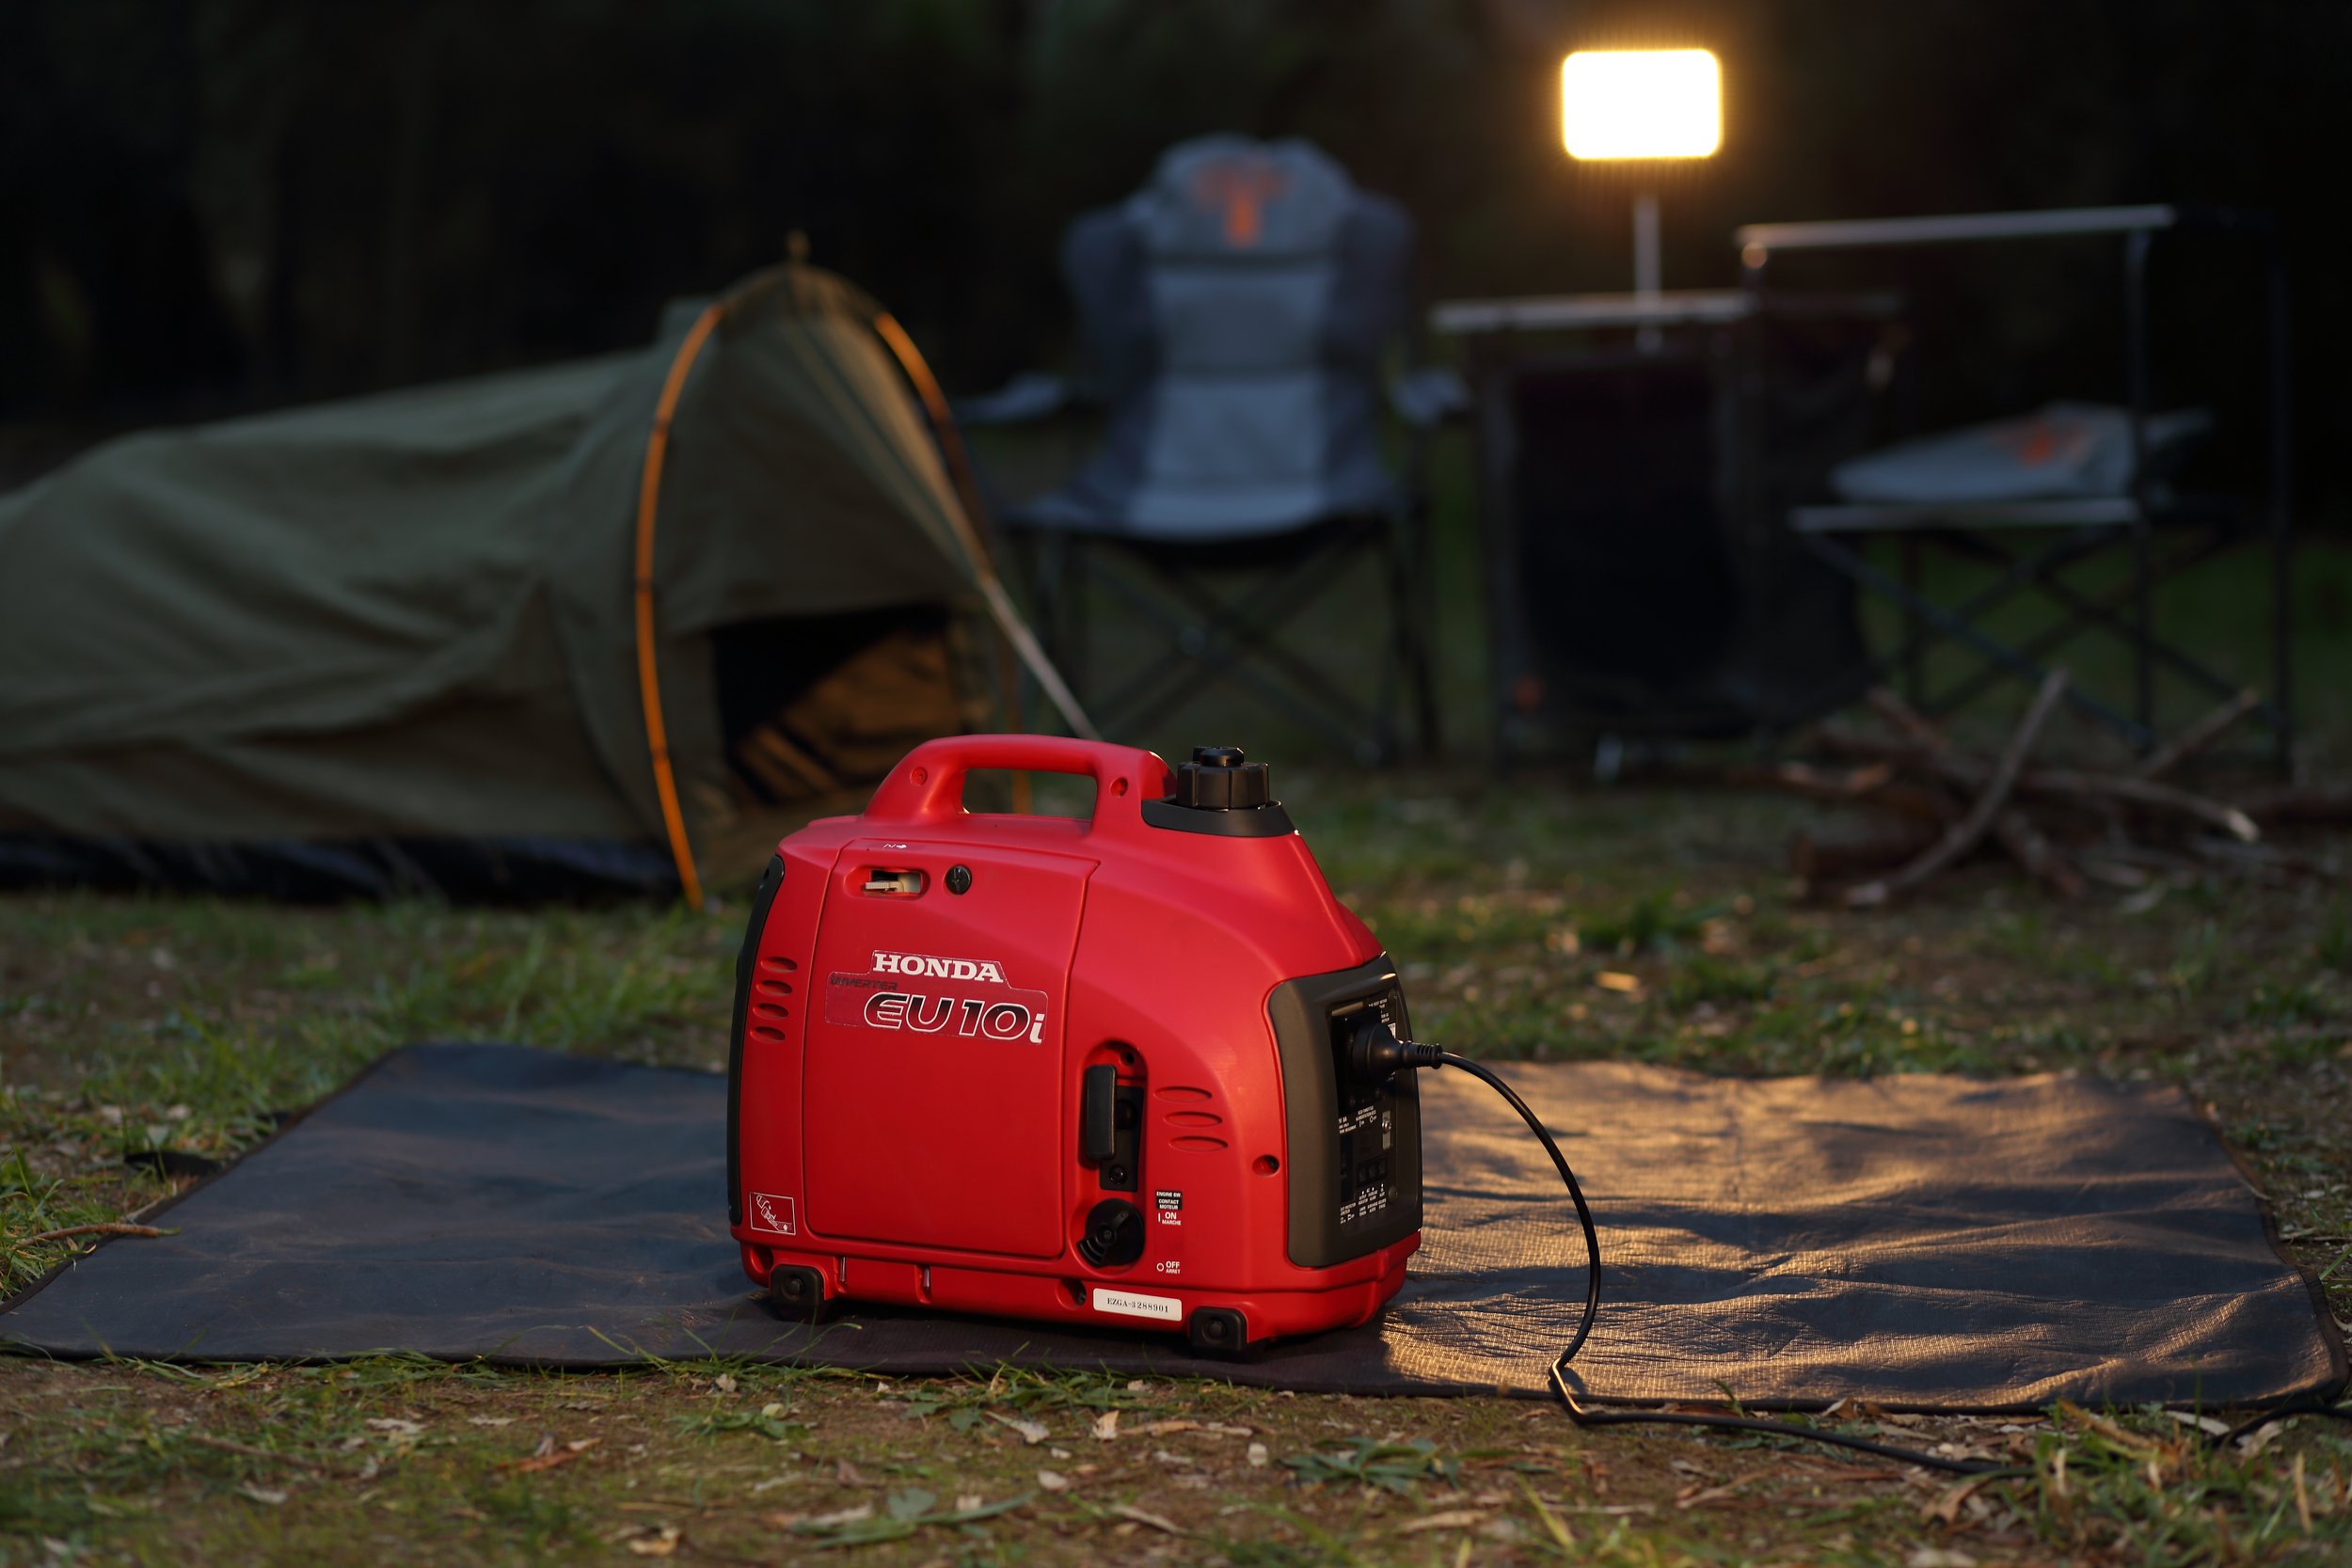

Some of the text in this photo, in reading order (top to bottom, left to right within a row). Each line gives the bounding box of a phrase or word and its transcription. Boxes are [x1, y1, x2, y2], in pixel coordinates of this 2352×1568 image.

[872, 953, 1003, 983] HONDA
[830, 975, 898, 990] INVERTER
[1165, 1212, 1177, 1220] ON
[1166, 1260, 1180, 1269] OFF
